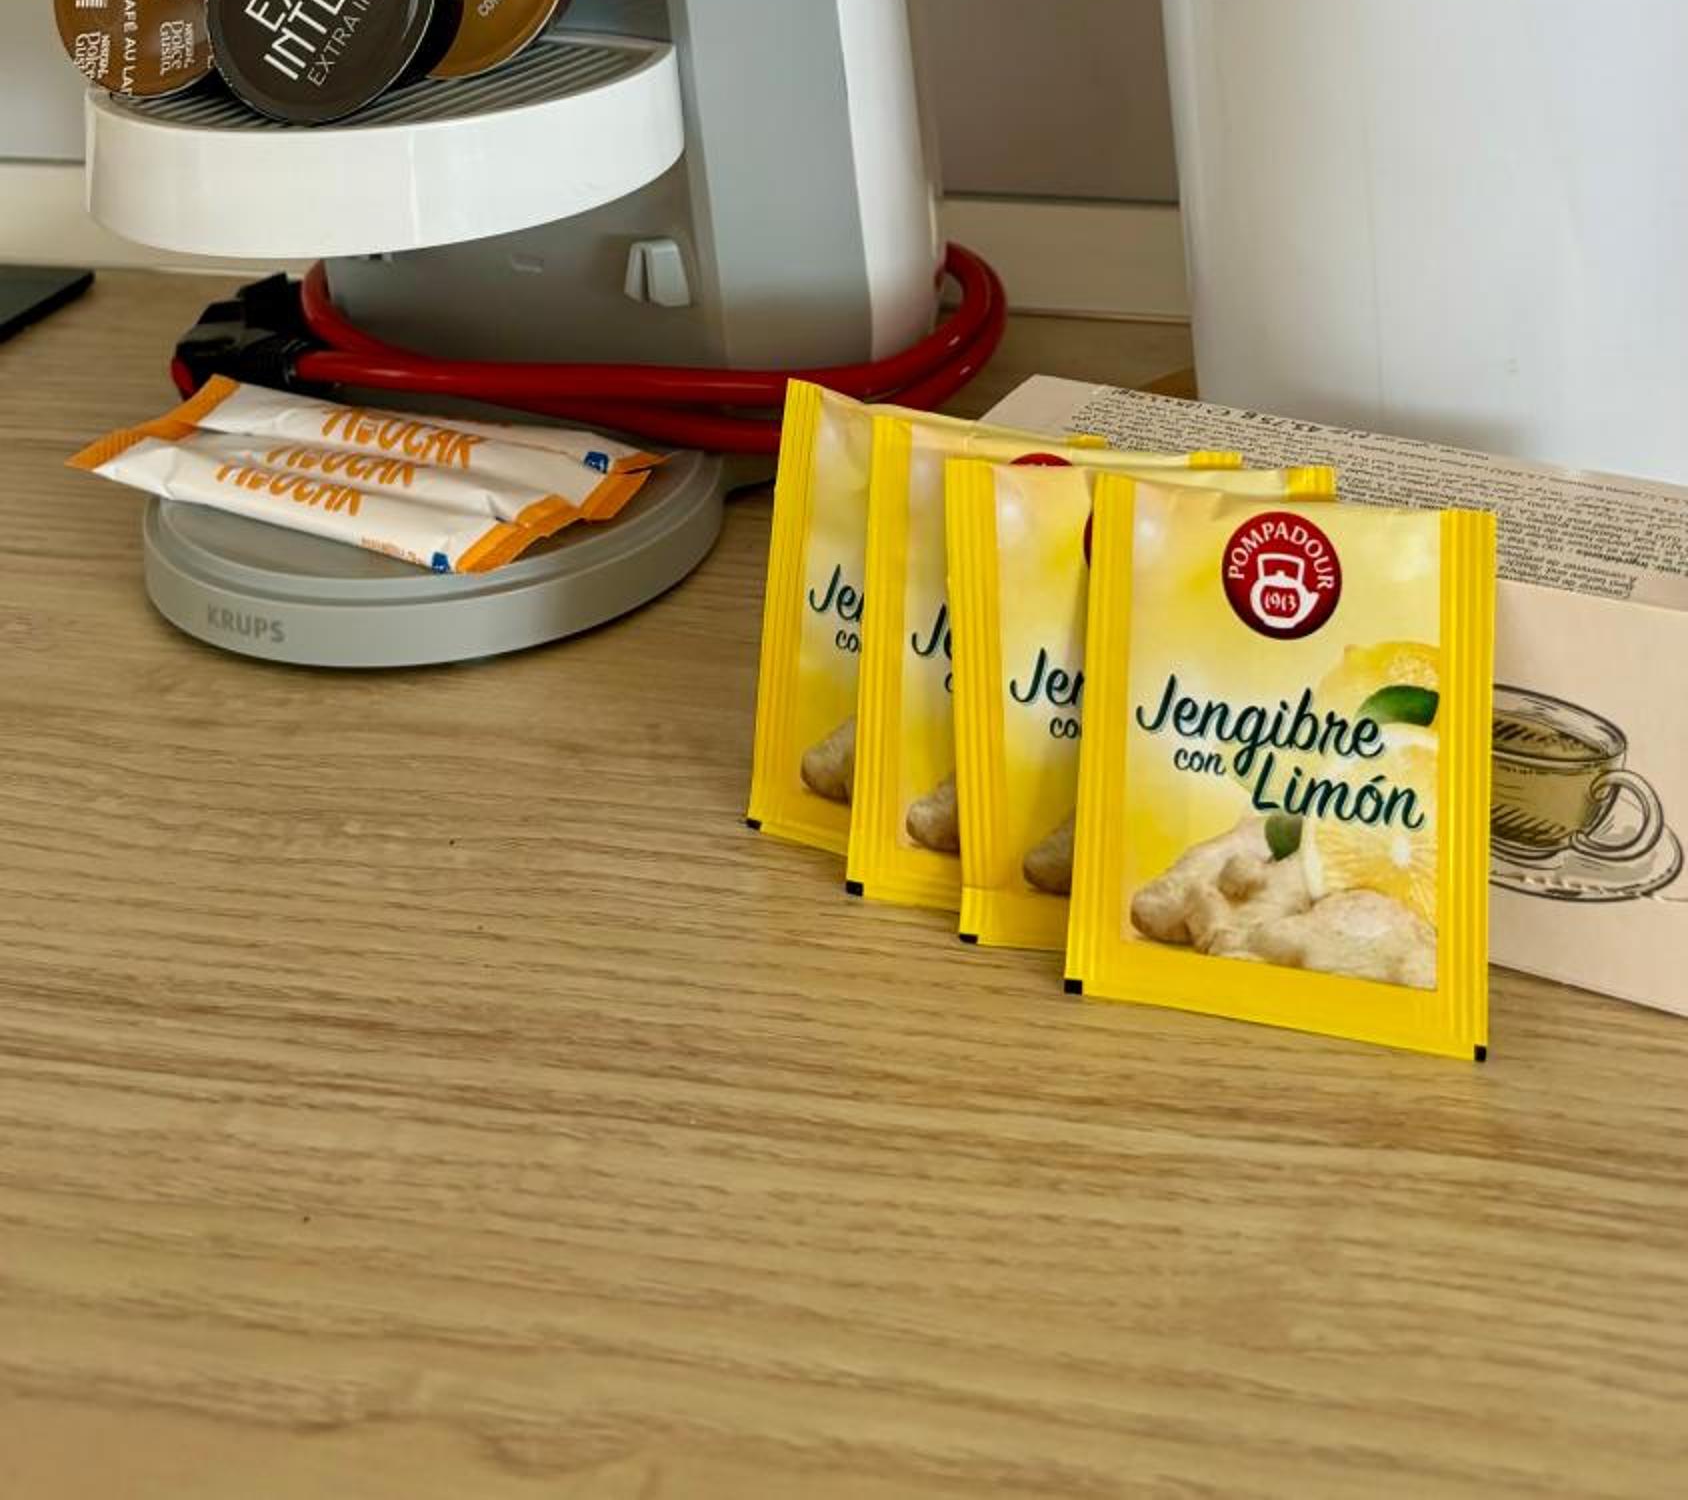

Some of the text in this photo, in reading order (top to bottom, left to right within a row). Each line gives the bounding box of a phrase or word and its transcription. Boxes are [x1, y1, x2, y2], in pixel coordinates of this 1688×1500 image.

[123, 37, 137, 62] AU
[307, 13, 361, 87] EXTRA
[1227, 520, 1336, 590] POMPADOUR
[207, 604, 287, 643] KRUPS
[1264, 592, 1297, 612] 1913
[1135, 673, 1385, 777] Jengibre
[1173, 746, 1227, 776] con
[1251, 751, 1426, 830] Limón
